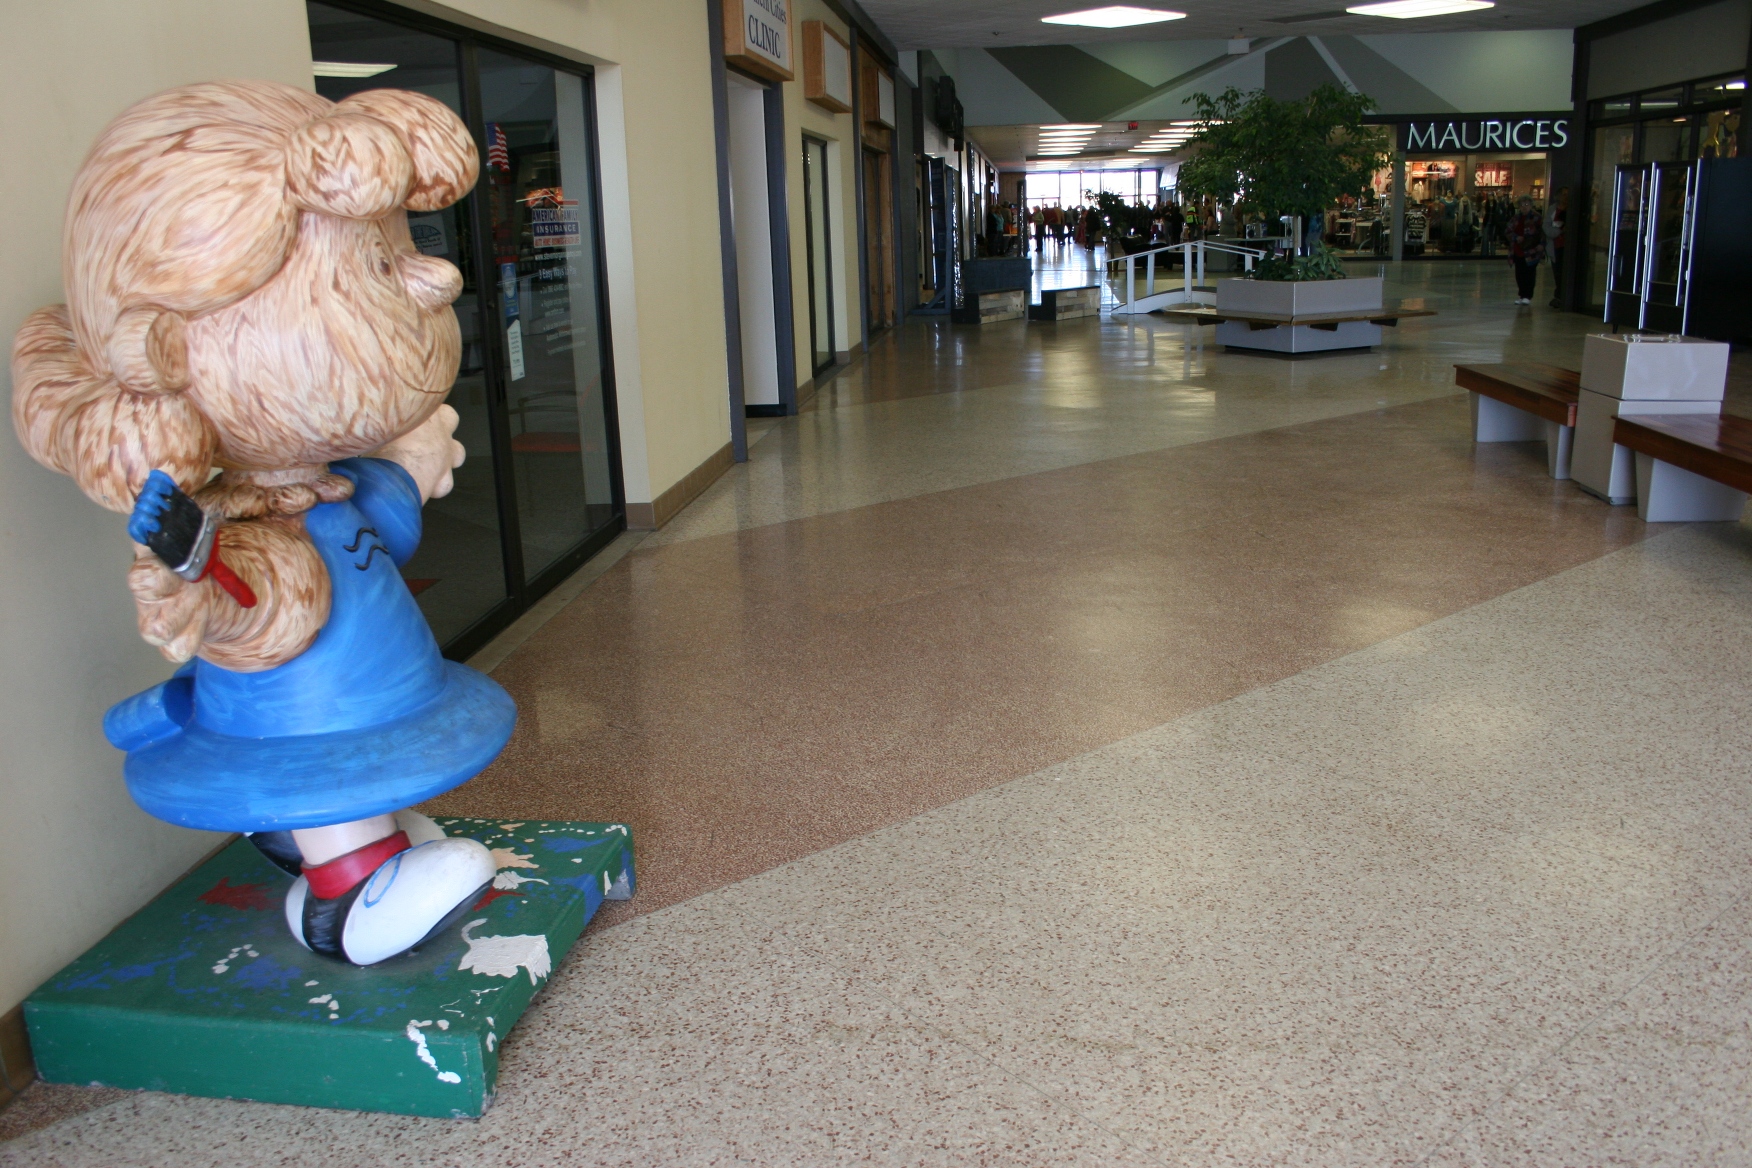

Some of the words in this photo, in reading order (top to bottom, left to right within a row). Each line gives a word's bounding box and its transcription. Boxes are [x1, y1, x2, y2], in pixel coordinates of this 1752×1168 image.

[748, 14, 781, 59] CLINIC
[1407, 120, 1568, 149] MAURICES
[1474, 170, 1508, 187] SALE
[532, 209, 560, 222] AMERICAN
[561, 208, 578, 221] FAMILY
[536, 224, 576, 234] INSURANCE
